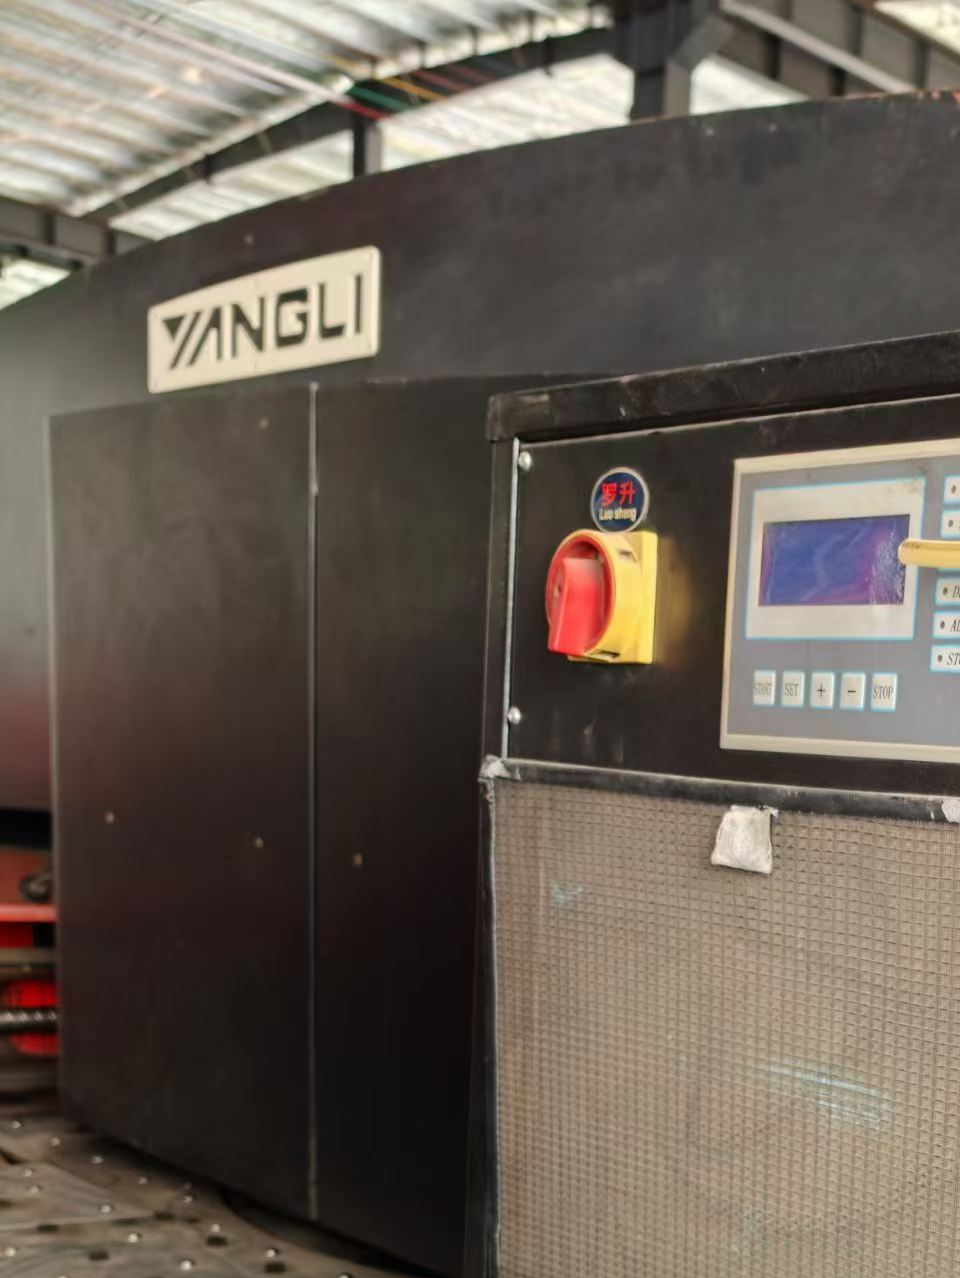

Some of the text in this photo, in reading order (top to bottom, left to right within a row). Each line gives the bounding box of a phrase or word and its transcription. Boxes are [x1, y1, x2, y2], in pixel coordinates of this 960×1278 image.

[162, 274, 362, 370] YANGLI
[784, 682, 799, 697] SET
[872, 685, 894, 700] STOP
